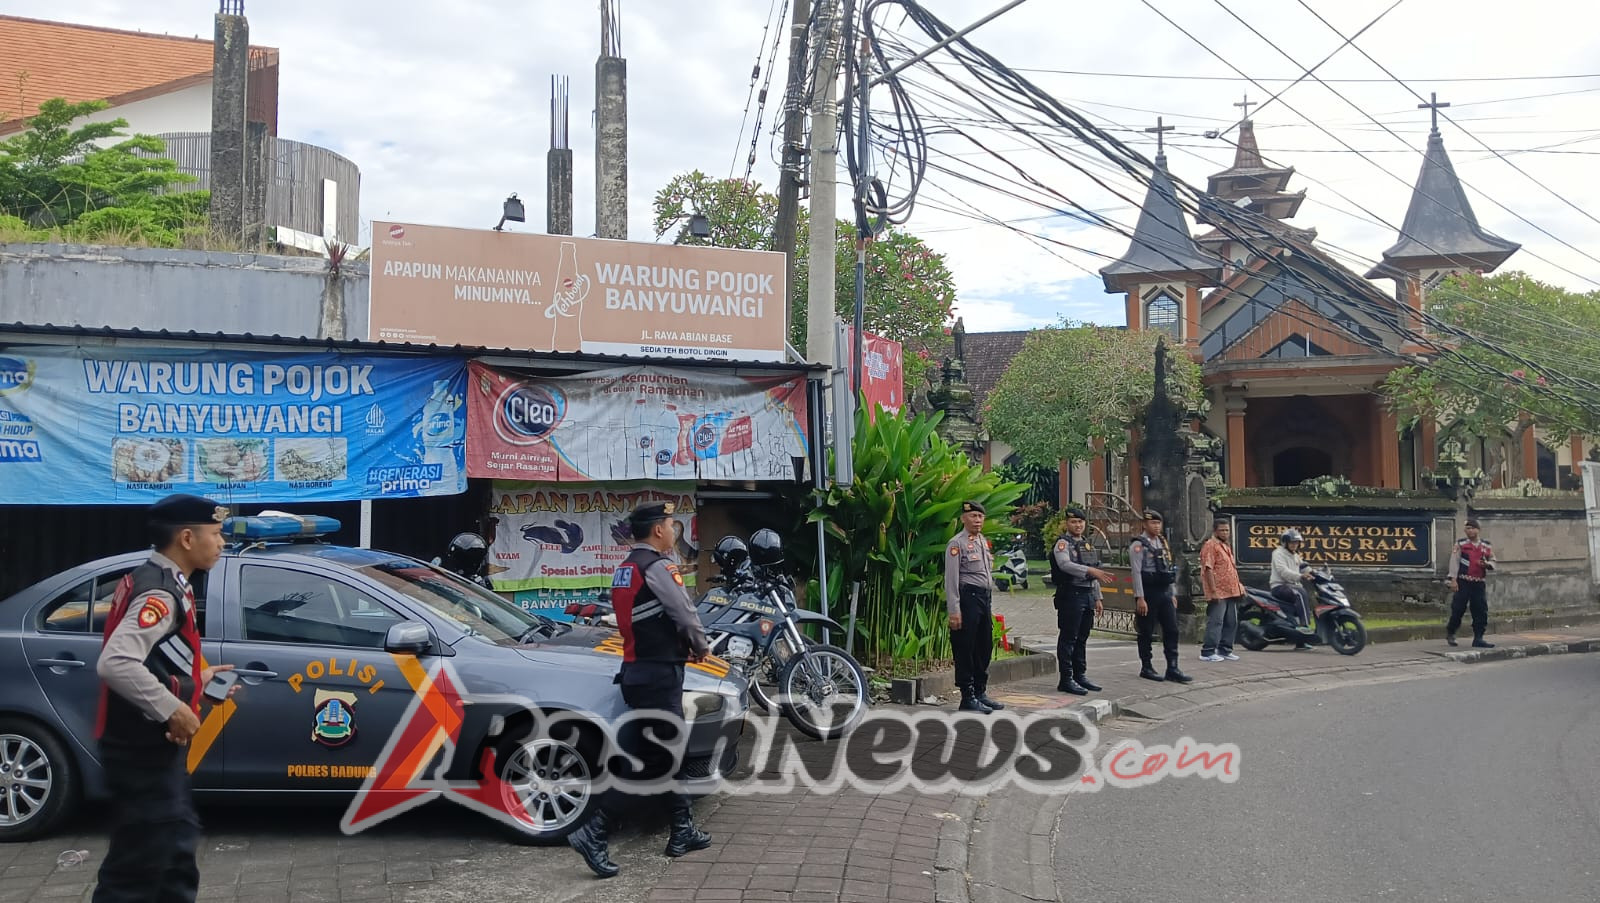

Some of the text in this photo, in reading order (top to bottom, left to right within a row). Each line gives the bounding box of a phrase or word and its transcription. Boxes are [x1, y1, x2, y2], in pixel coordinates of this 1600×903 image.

[384, 260, 542, 287] APAPUN MAKANANNYA
[595, 262, 775, 295] WARUNG POJOK
[605, 287, 764, 319] BANYUWANGI
[654, 330, 678, 341] RAYA
[679, 332, 708, 342] ABIAN
[709, 333, 733, 343] BASE
[640, 345, 728, 357] SEDIA TEH BOTOL DINGIN
[83, 359, 375, 402] WARUNG POJOK
[621, 373, 689, 386] Kemurnian
[640, 384, 705, 398] Ramadhan
[510, 396, 554, 425] Cleo
[117, 403, 343, 434] BANYUWANGI
[3, 424, 33, 436] HIDUP
[695, 430, 714, 444] Cleo
[490, 451, 518, 461] Murni
[486, 460, 555, 473] Segar Rasanya
[368, 465, 441, 483] #GENERASI
[126, 483, 173, 491] NASI CAMPUR
[216, 482, 247, 490] LALAPAN
[288, 480, 333, 489] NASI GORENG
[381, 477, 431, 494] prima
[1328, 526, 1416, 538] KATOLIK
[1358, 538, 1418, 551] RAJA
[495, 552, 520, 560] AYAM
[541, 563, 615, 577] Spesial Sambal
[740, 601, 776, 615] POLISI
[287, 657, 385, 694] POLISI
[287, 764, 377, 778] POLRES BADUNG
